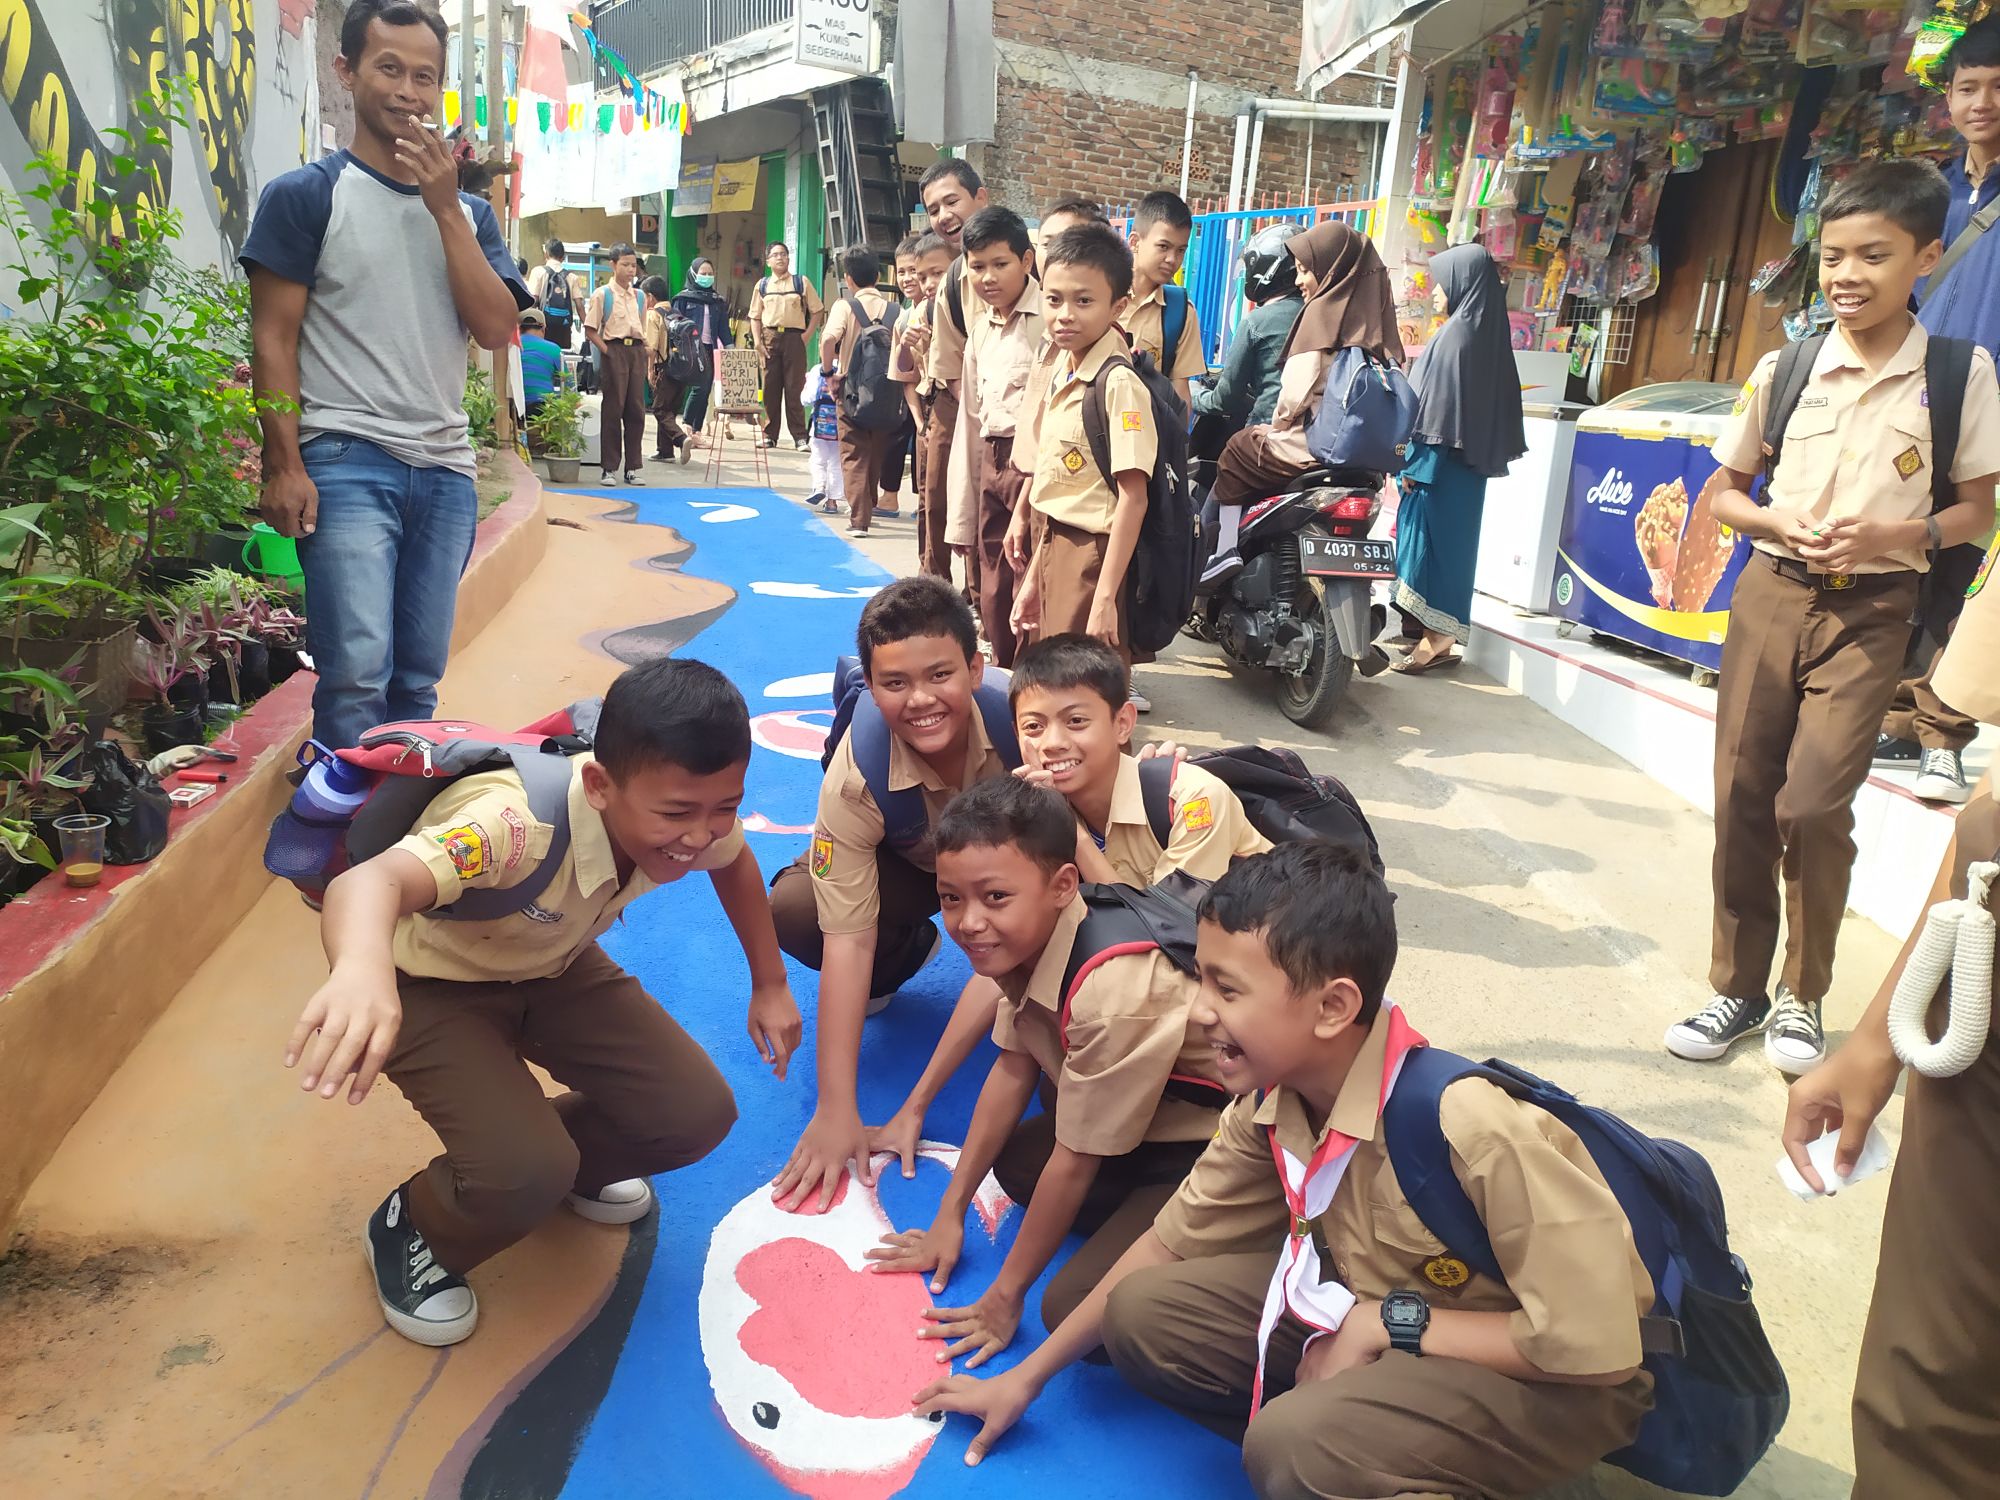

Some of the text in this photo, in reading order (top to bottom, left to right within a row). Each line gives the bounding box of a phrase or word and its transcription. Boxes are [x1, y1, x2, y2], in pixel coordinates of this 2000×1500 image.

[825, 18, 846, 30] MAS
[819, 32, 850, 47] KUMIS
[805, 44, 863, 64] SEDERHANA
[721, 351, 757, 360] PANITIA
[1586, 466, 1634, 506] Aice
[1306, 541, 1390, 560] D 4037 SBJ
[504, 811, 523, 830] KOTA
